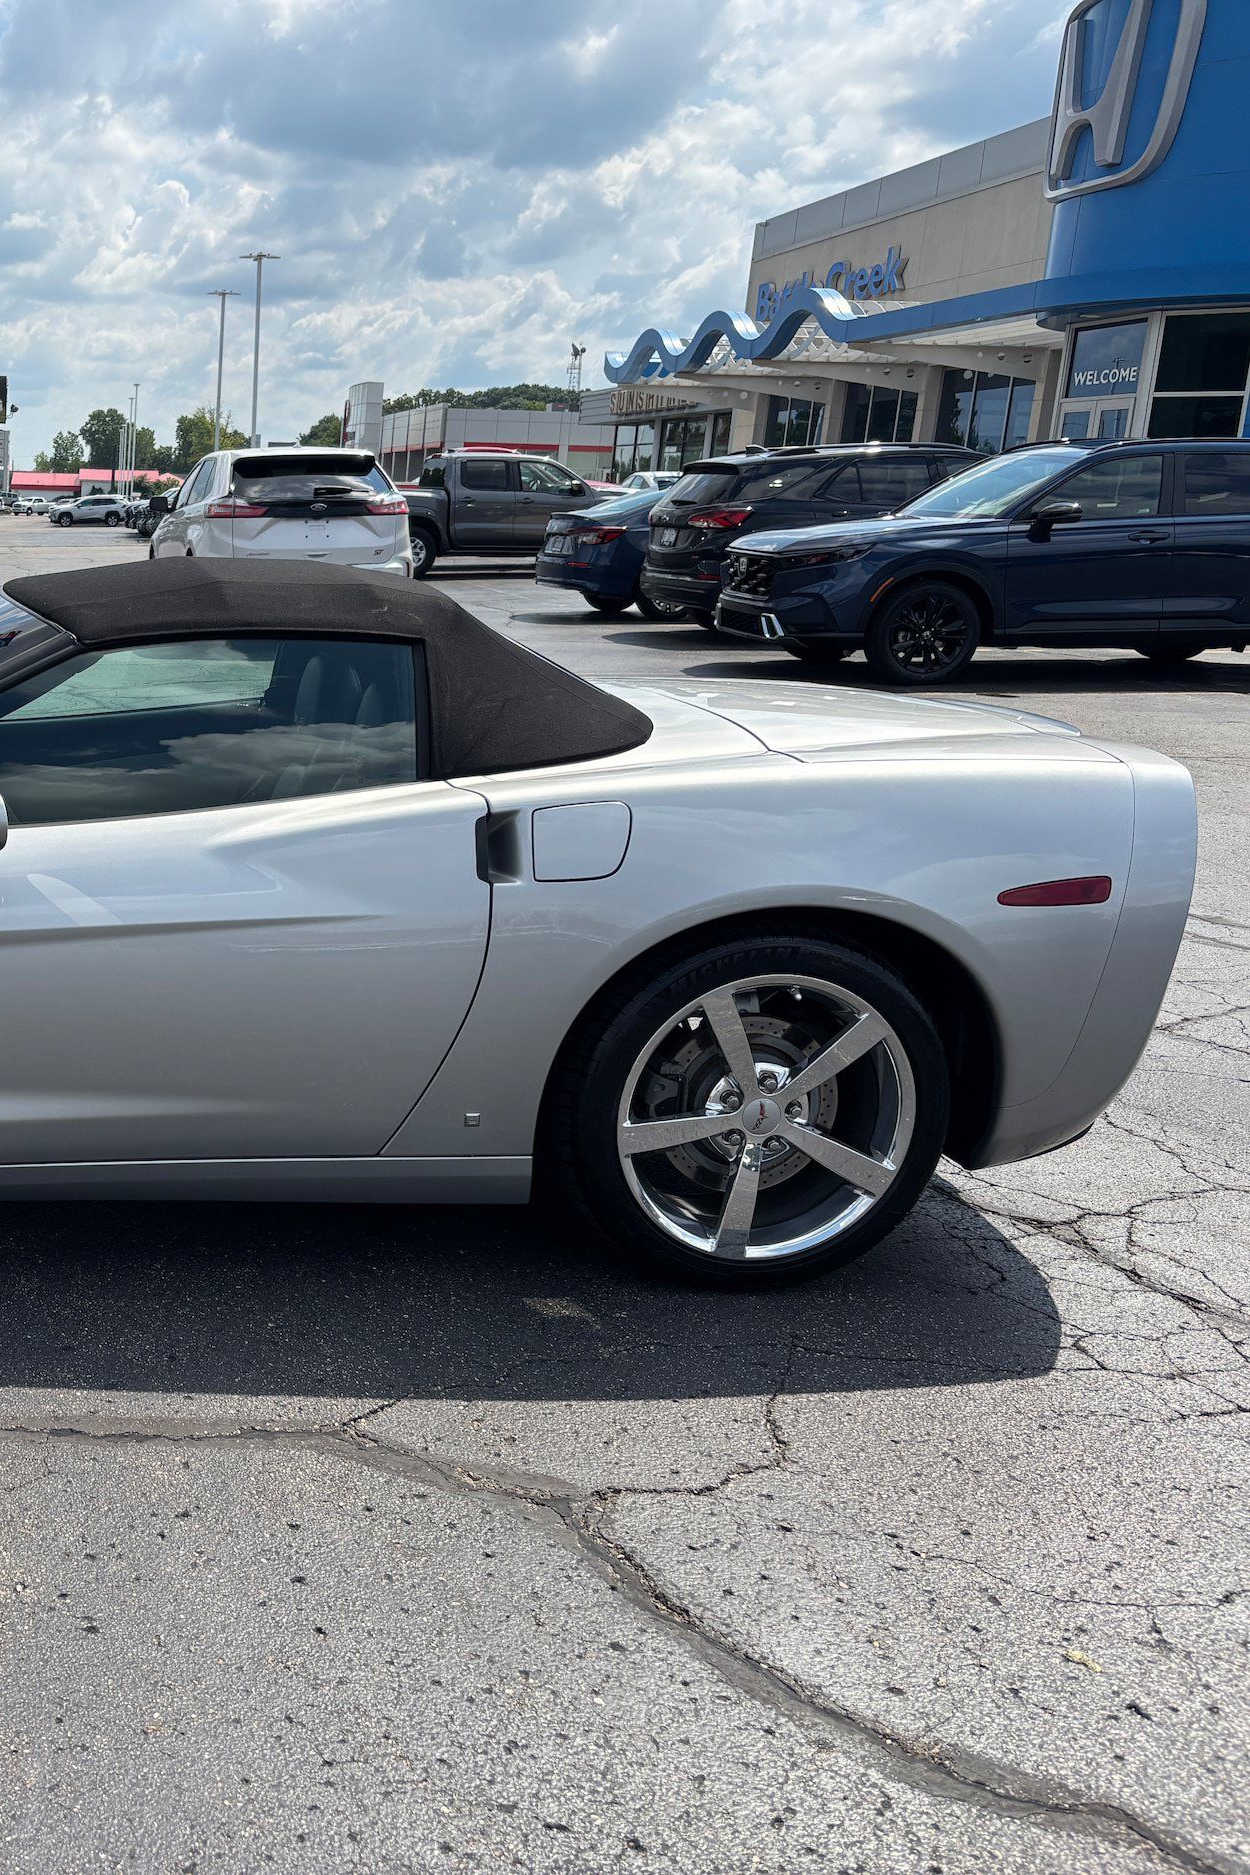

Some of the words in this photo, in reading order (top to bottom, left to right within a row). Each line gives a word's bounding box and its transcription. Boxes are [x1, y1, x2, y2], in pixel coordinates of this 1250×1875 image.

[755, 270, 824, 322] Bat
[825, 245, 910, 301] Creek
[1074, 366, 1138, 386] WELCOME
